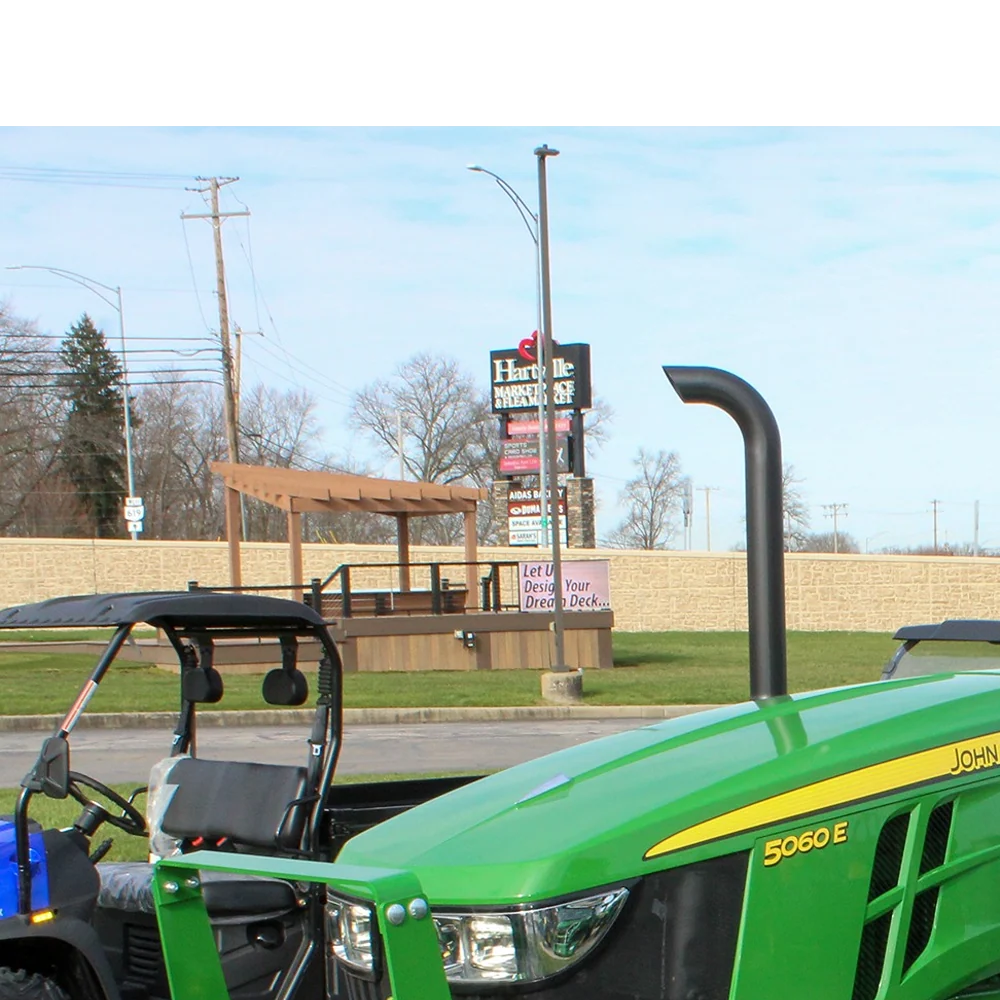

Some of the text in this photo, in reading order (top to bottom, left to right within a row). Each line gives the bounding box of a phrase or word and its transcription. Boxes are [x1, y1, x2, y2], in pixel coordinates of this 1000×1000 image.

[509, 490, 532, 500] AIDAS
[127, 509, 141, 517] 619
[523, 564, 542, 577] Let
[565, 579, 591, 592] Your
[950, 743, 999, 773] JOHN
